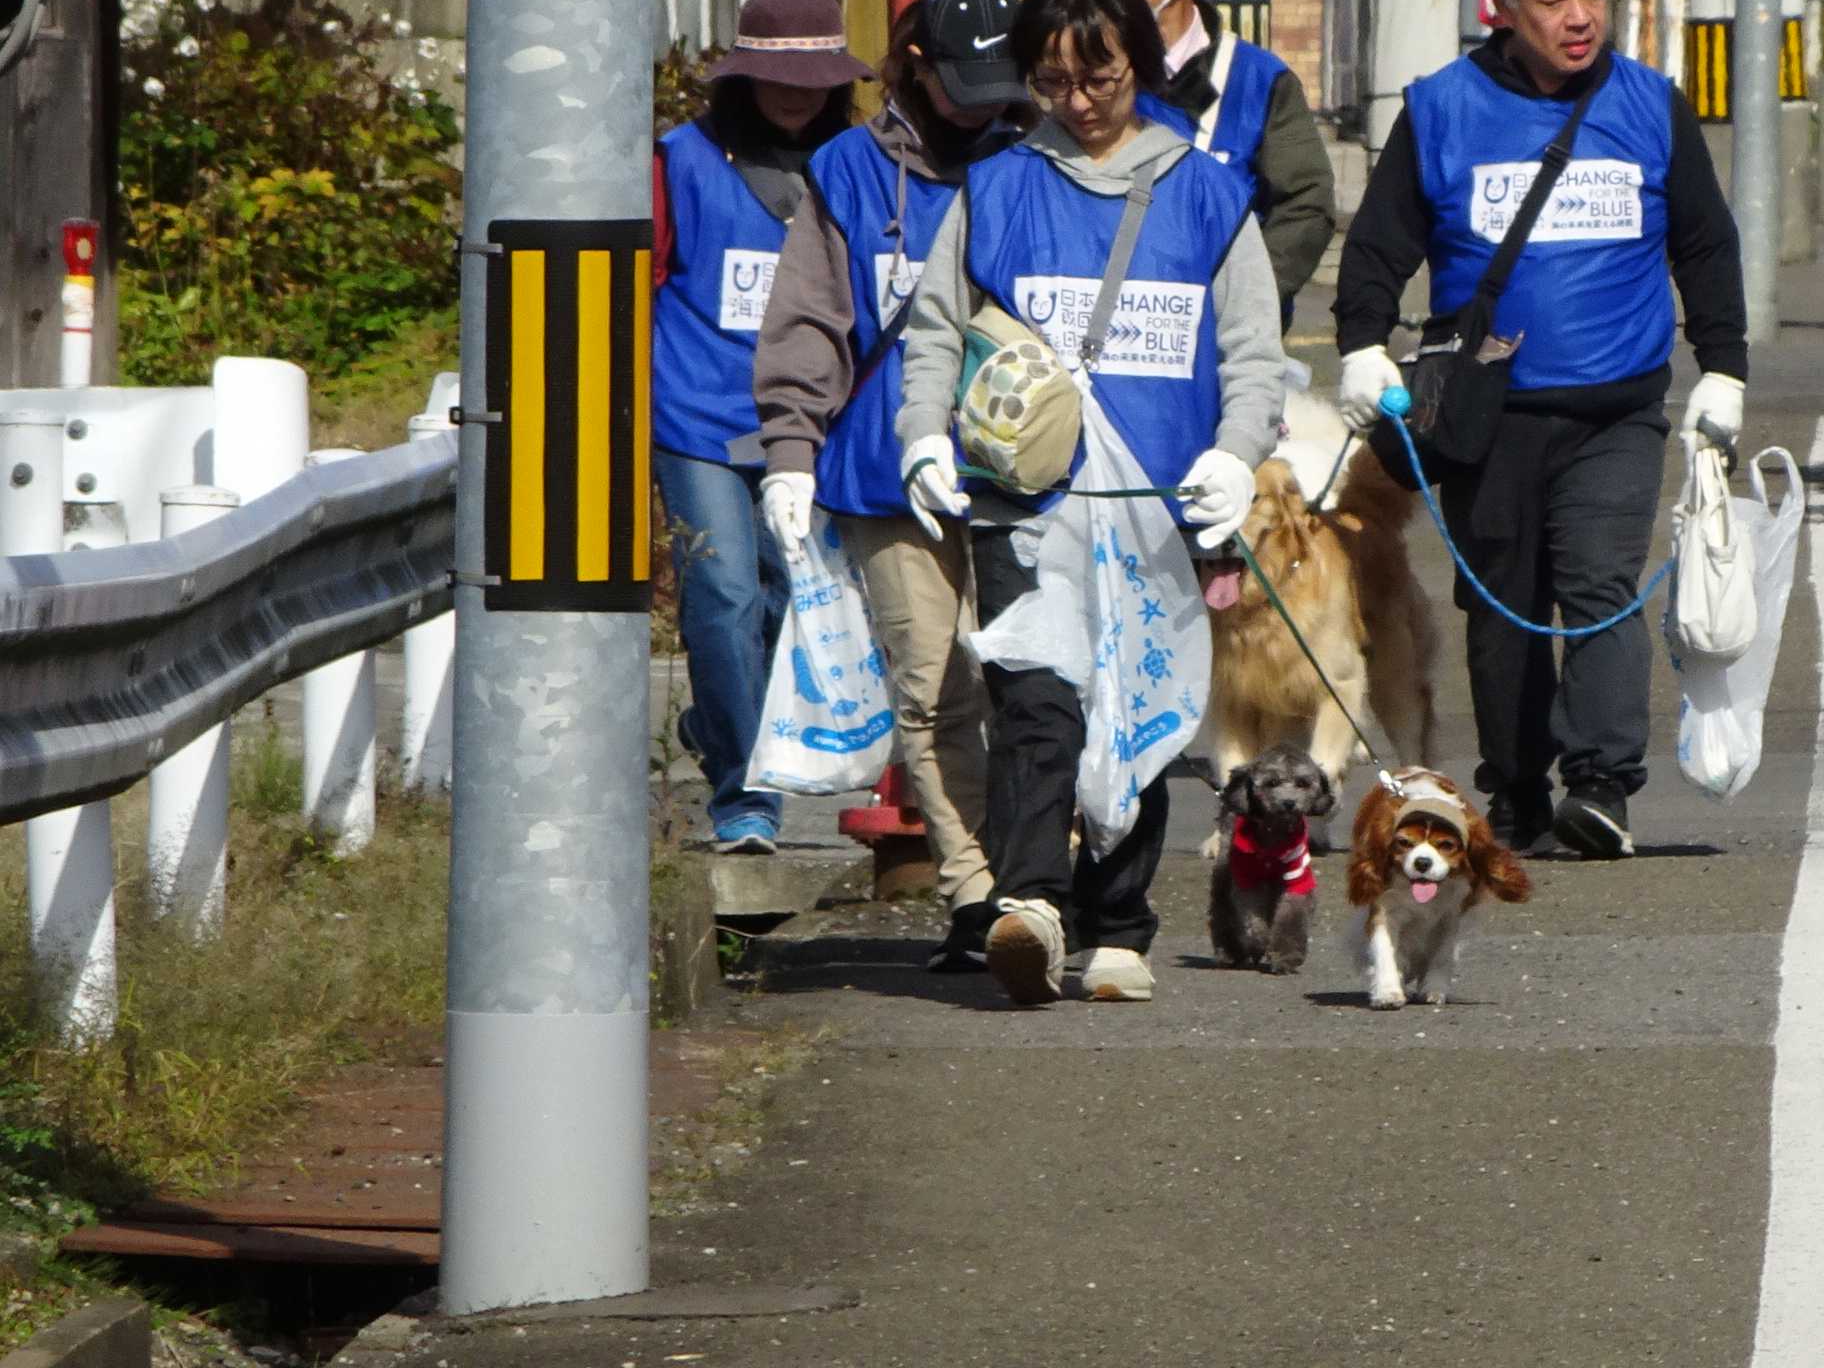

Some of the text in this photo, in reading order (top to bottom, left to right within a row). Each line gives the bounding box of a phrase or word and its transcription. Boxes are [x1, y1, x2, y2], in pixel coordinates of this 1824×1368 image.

[1554, 170, 1633, 187] CHANGE
[1589, 200, 1634, 218] BLUE
[1114, 293, 1193, 316] HANGE
[1146, 317, 1191, 333] FOR THE
[1145, 332, 1189, 354] BLUE
